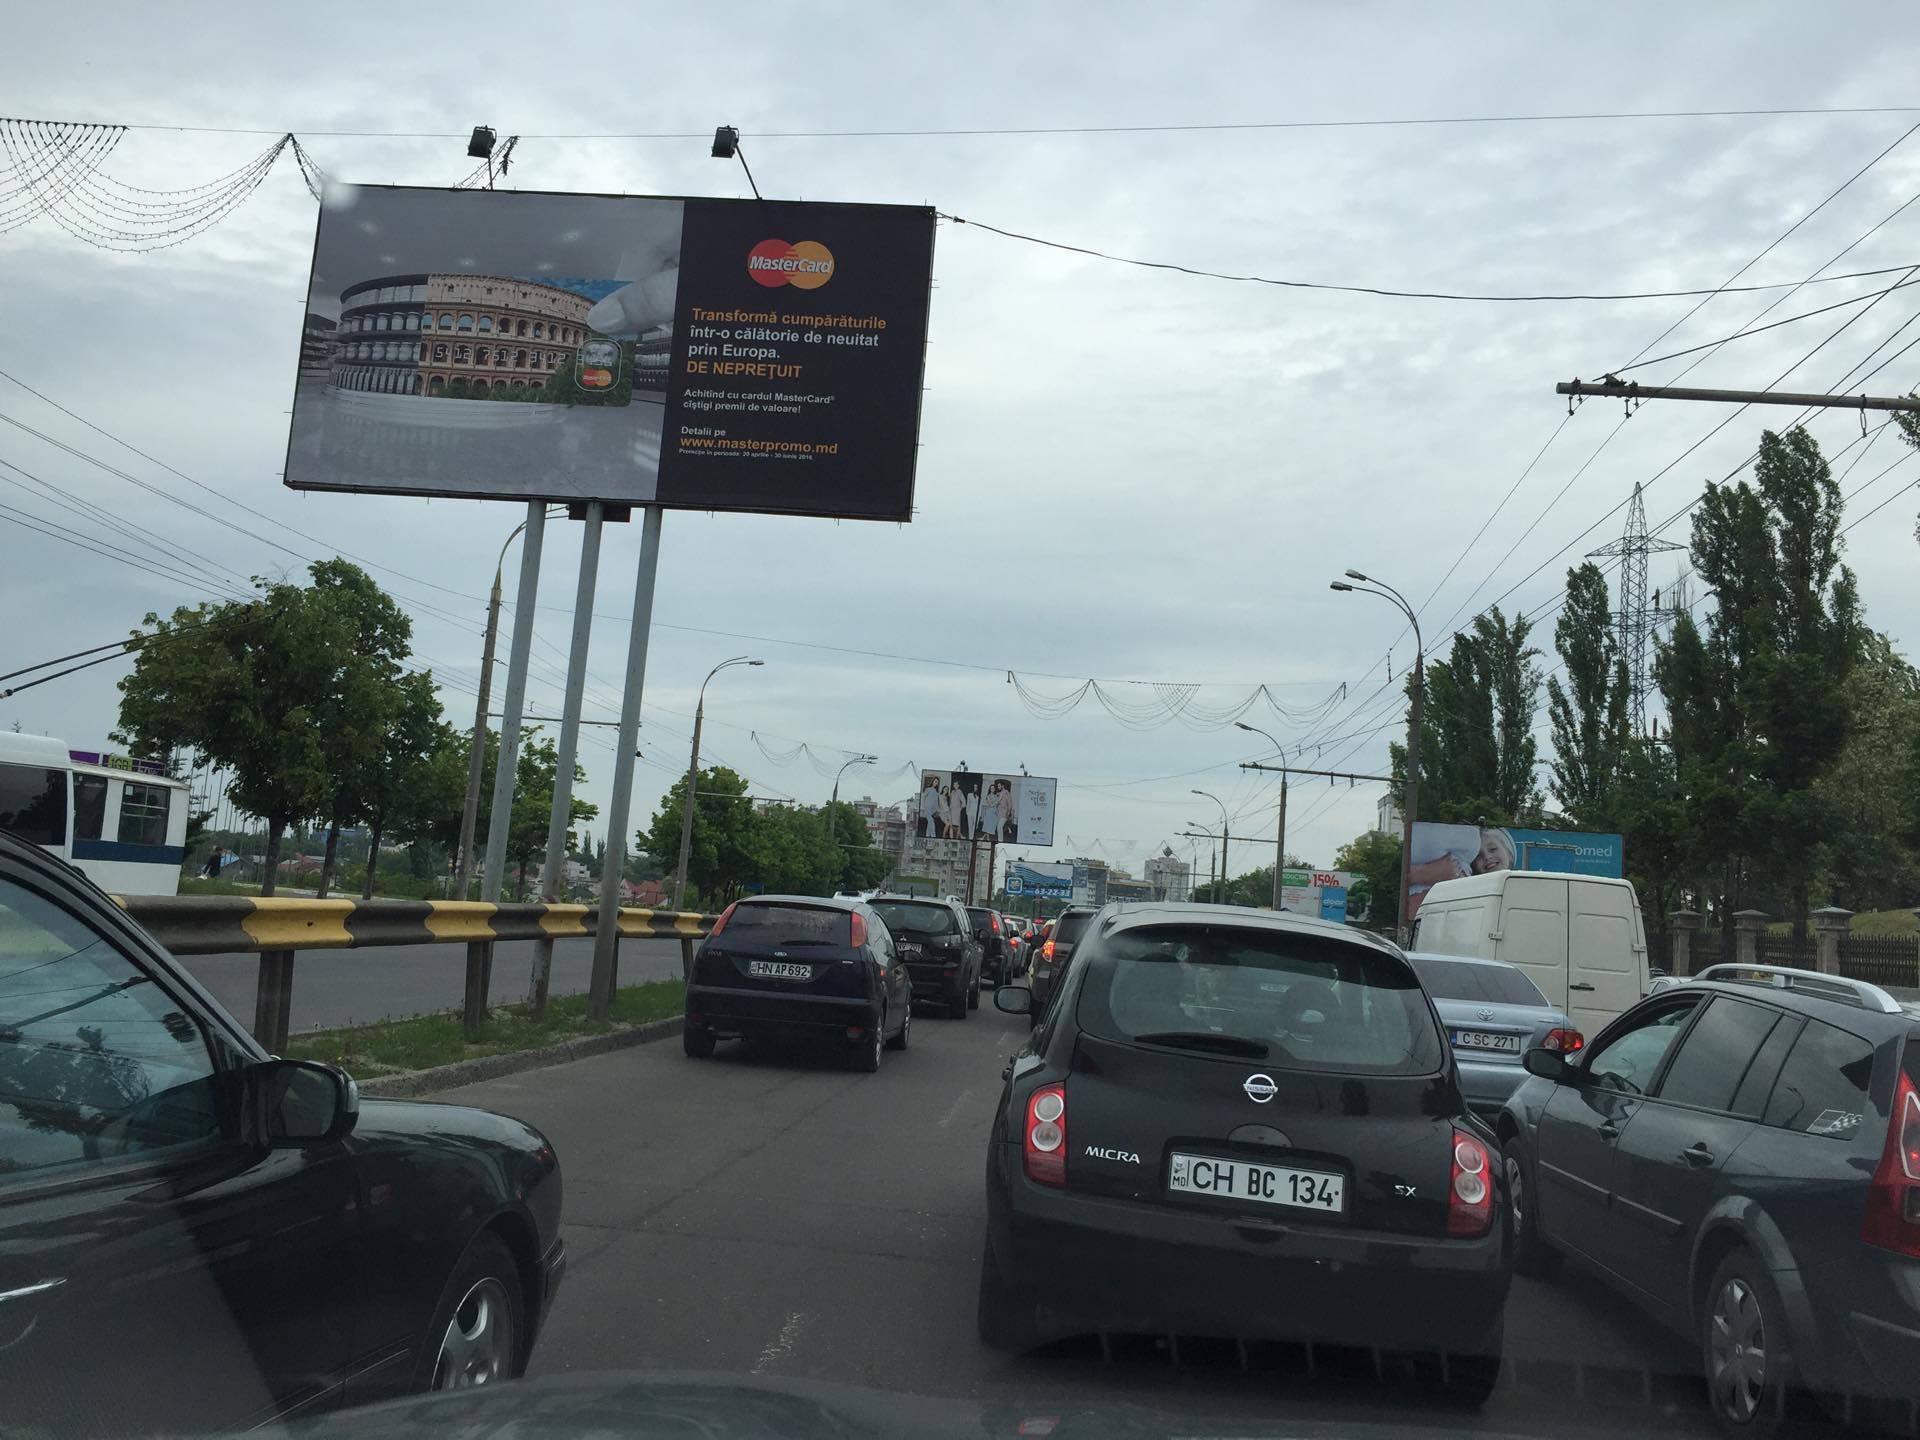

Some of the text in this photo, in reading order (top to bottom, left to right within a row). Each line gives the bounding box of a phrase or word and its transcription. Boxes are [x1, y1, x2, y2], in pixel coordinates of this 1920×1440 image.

[749, 256, 832, 273] MasterCard
[692, 307, 887, 329] Transformă cumpărăturile
[689, 325, 879, 346] într-o călătorie de neuitat
[688, 344, 780, 360] prin Europa.
[686, 360, 708, 374] DE
[741, 391, 772, 400] cardul
[714, 401, 745, 411] premii
[747, 401, 760, 411] de
[762, 403, 801, 413] valoare!
[681, 426, 726, 437] Detalii pe
[680, 437, 838, 454] www.masterpromo.md
[757, 962, 773, 974] HN
[775, 964, 787, 975] AP
[788, 965, 808, 977] 692
[1462, 1033, 1514, 1048] C SC 271
[1085, 1145, 1140, 1164] MICRA
[1172, 1175, 1186, 1187] MD
[1192, 1161, 1333, 1207] CH BC 134
[1394, 1185, 1416, 1197] SX
